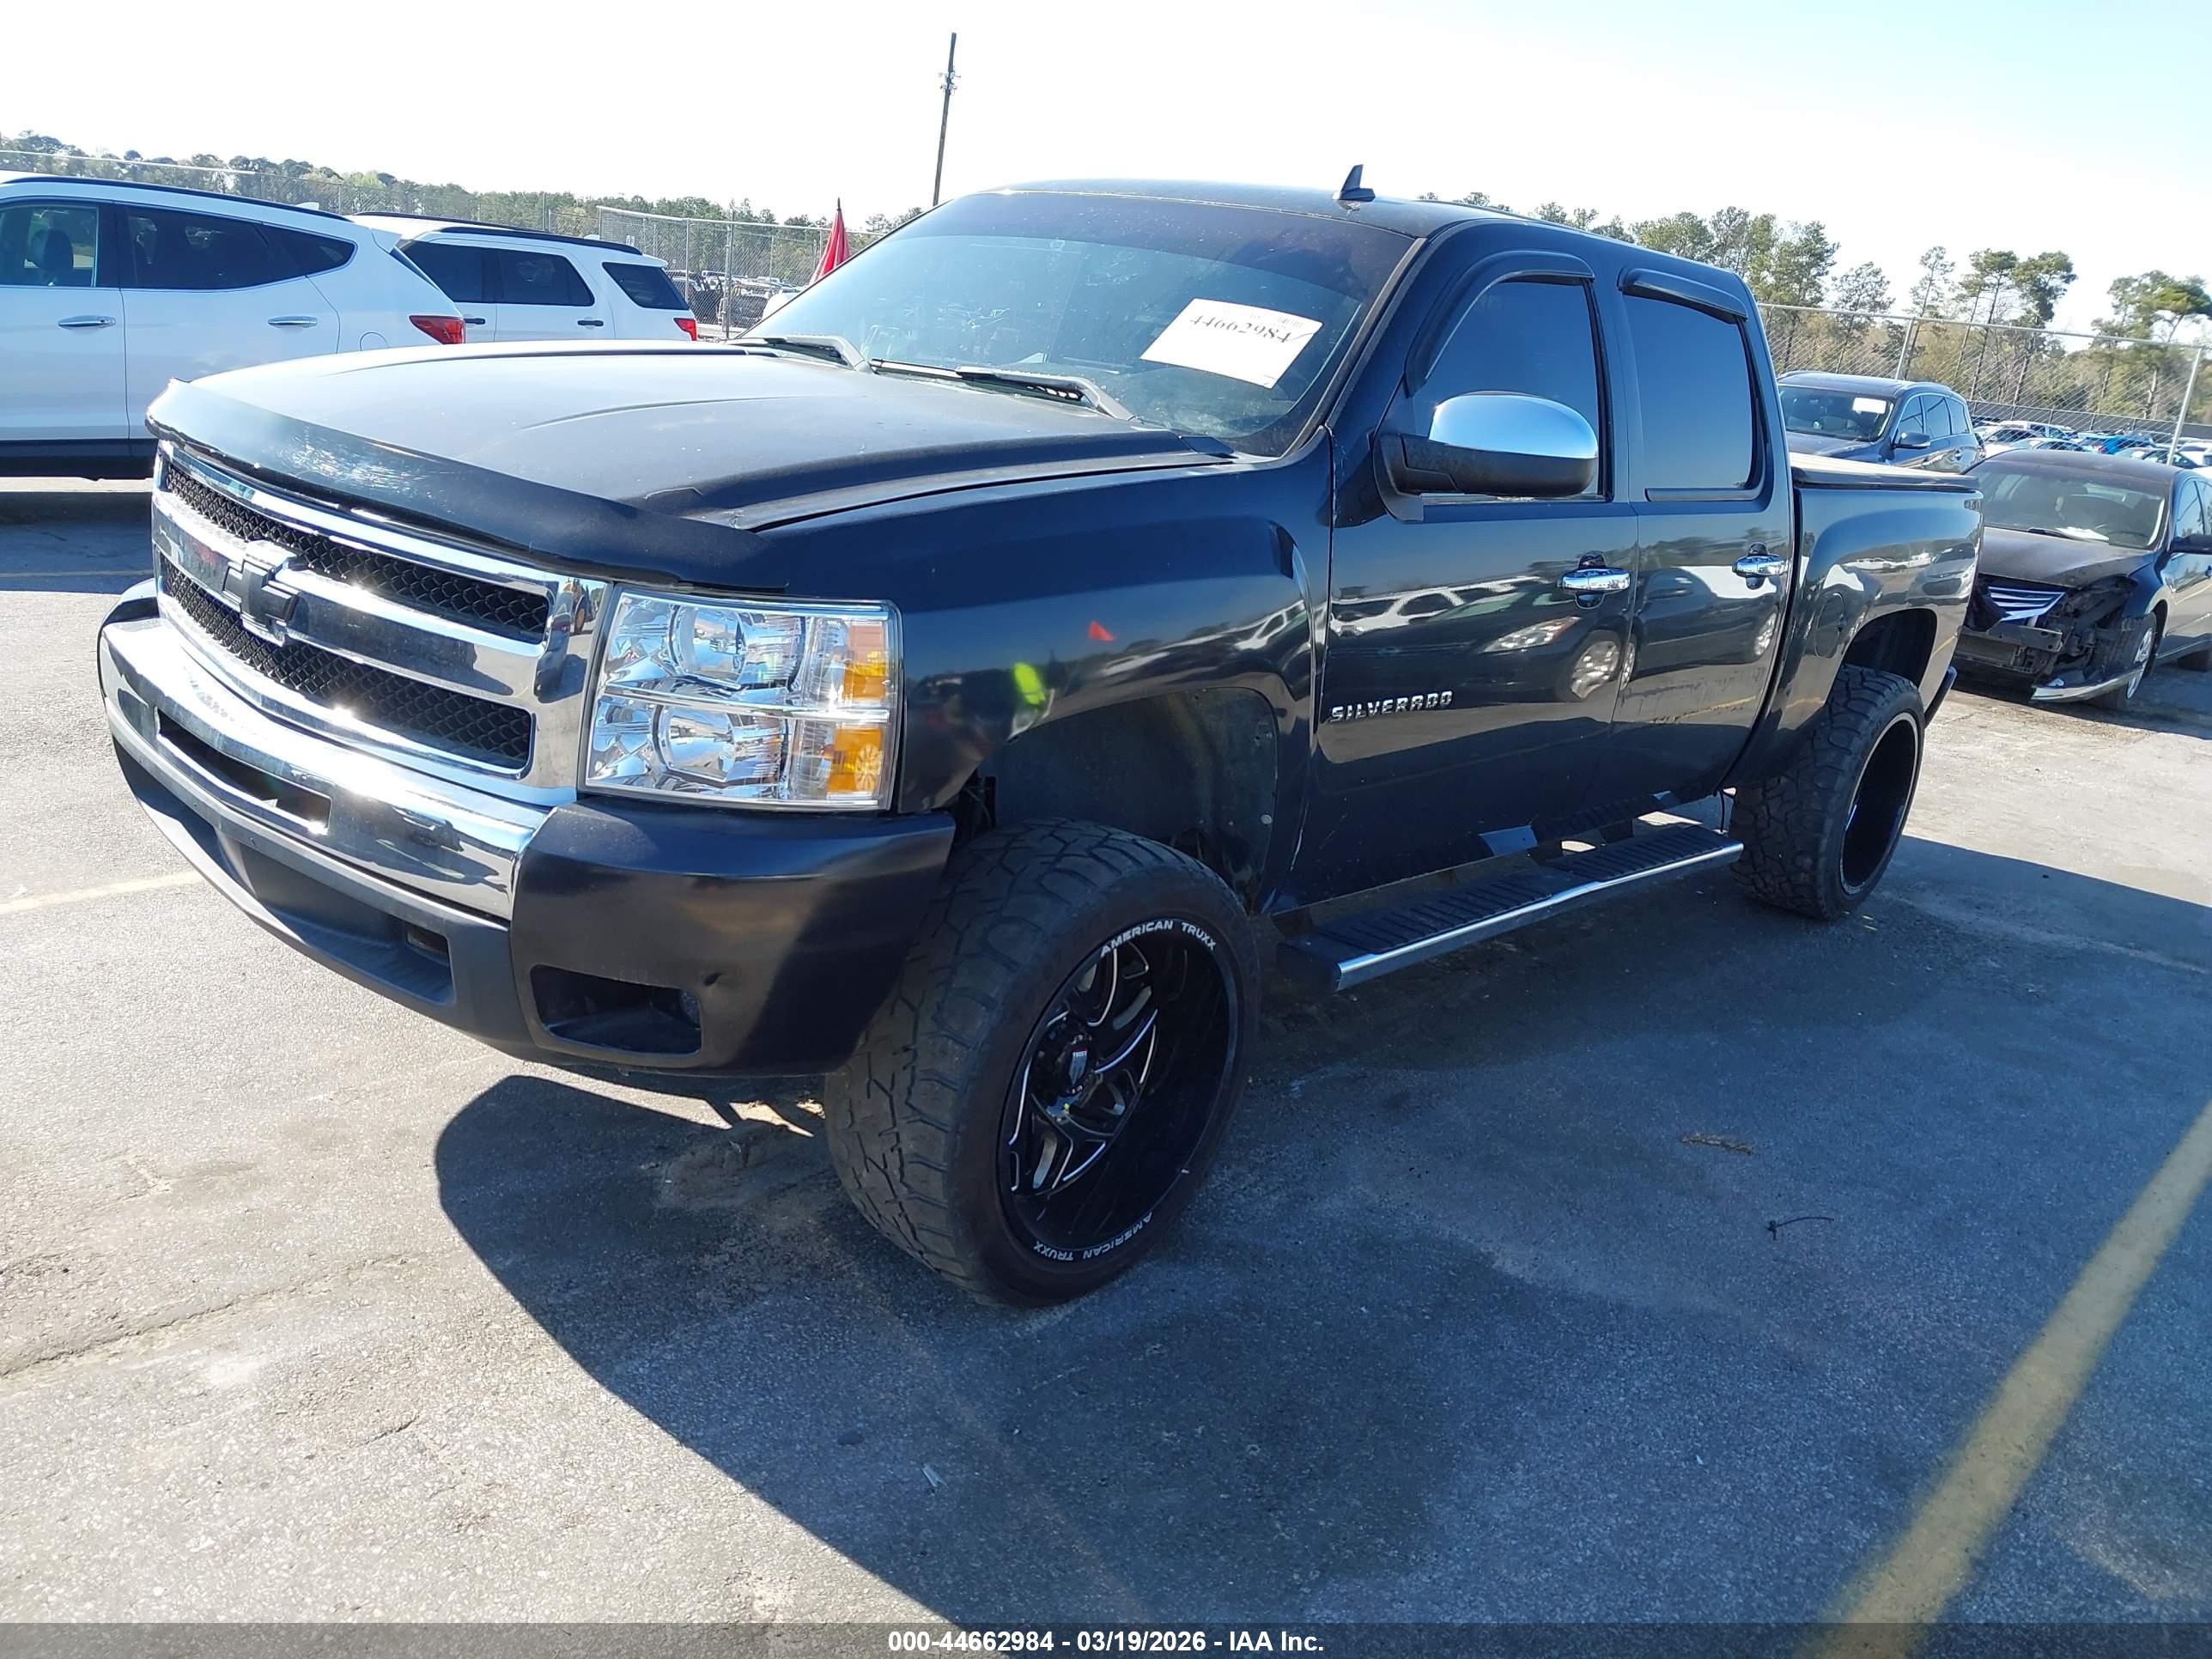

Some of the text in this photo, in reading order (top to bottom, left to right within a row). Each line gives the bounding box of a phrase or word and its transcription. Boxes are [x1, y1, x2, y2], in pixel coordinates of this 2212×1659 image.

[1330, 690, 1453, 722] SILVERADO
[1100, 920, 1217, 957] AMERICAN TRUXX
[1033, 1212, 1153, 1261] AMERICAN TRUXX
